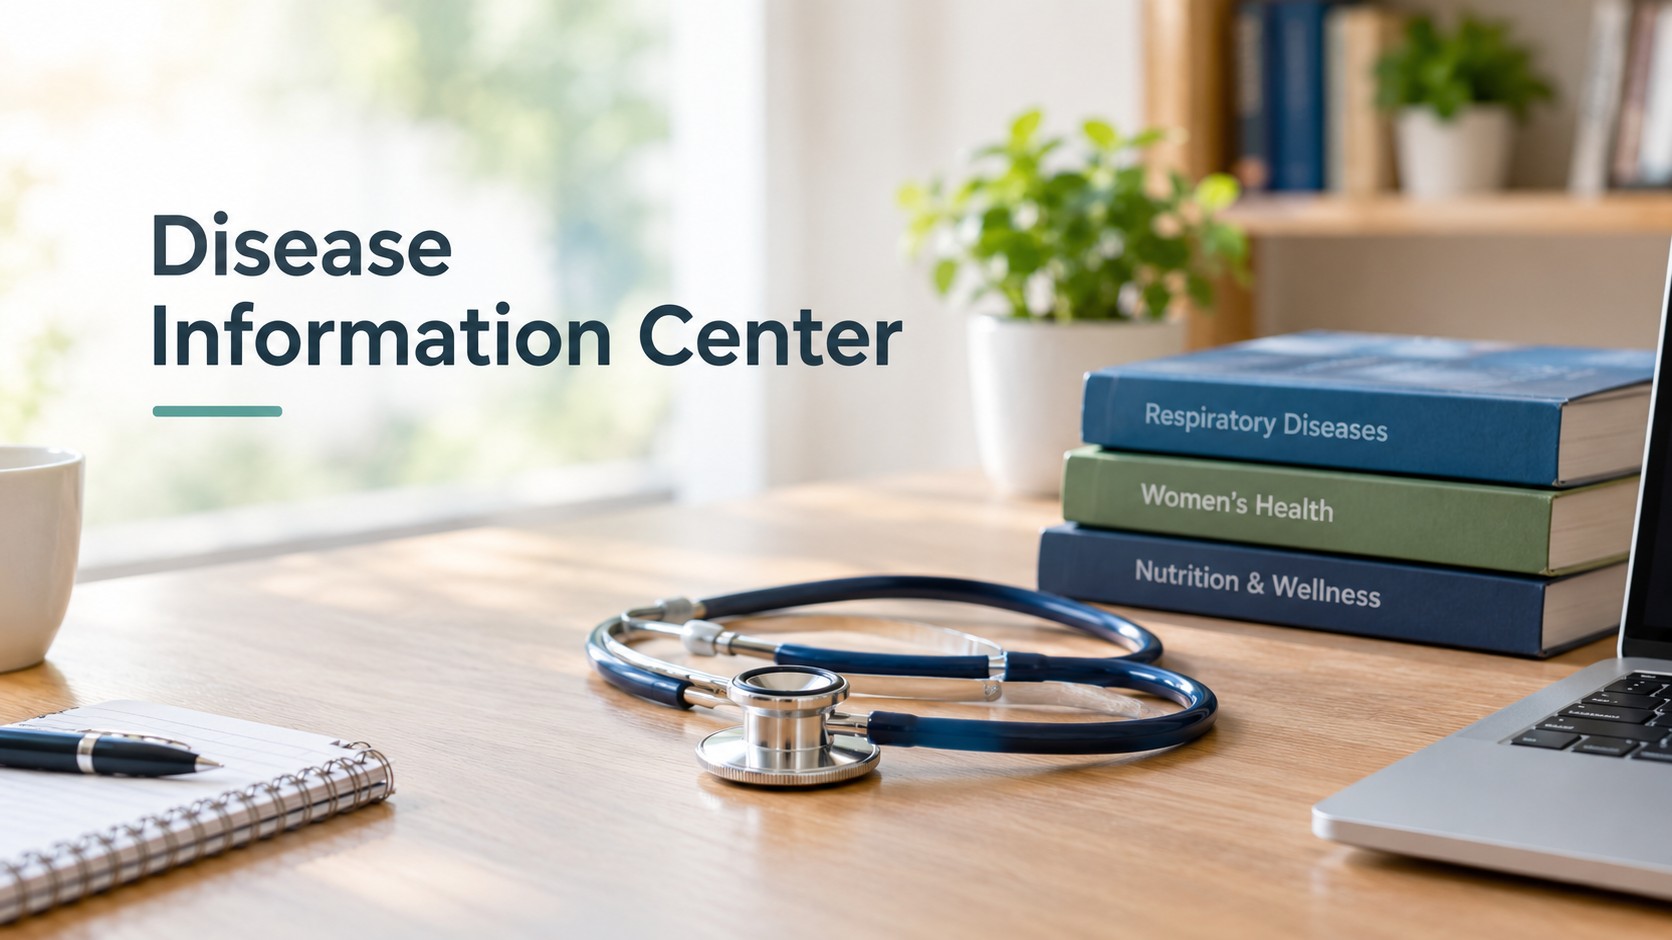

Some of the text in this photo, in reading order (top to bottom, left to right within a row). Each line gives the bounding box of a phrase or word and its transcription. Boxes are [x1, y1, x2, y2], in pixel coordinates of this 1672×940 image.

[1145, 402, 1389, 443] Respiratory Diseases
[1141, 482, 1334, 523] Women’s Health
[1135, 558, 1382, 609] Nutrition & Wellness
